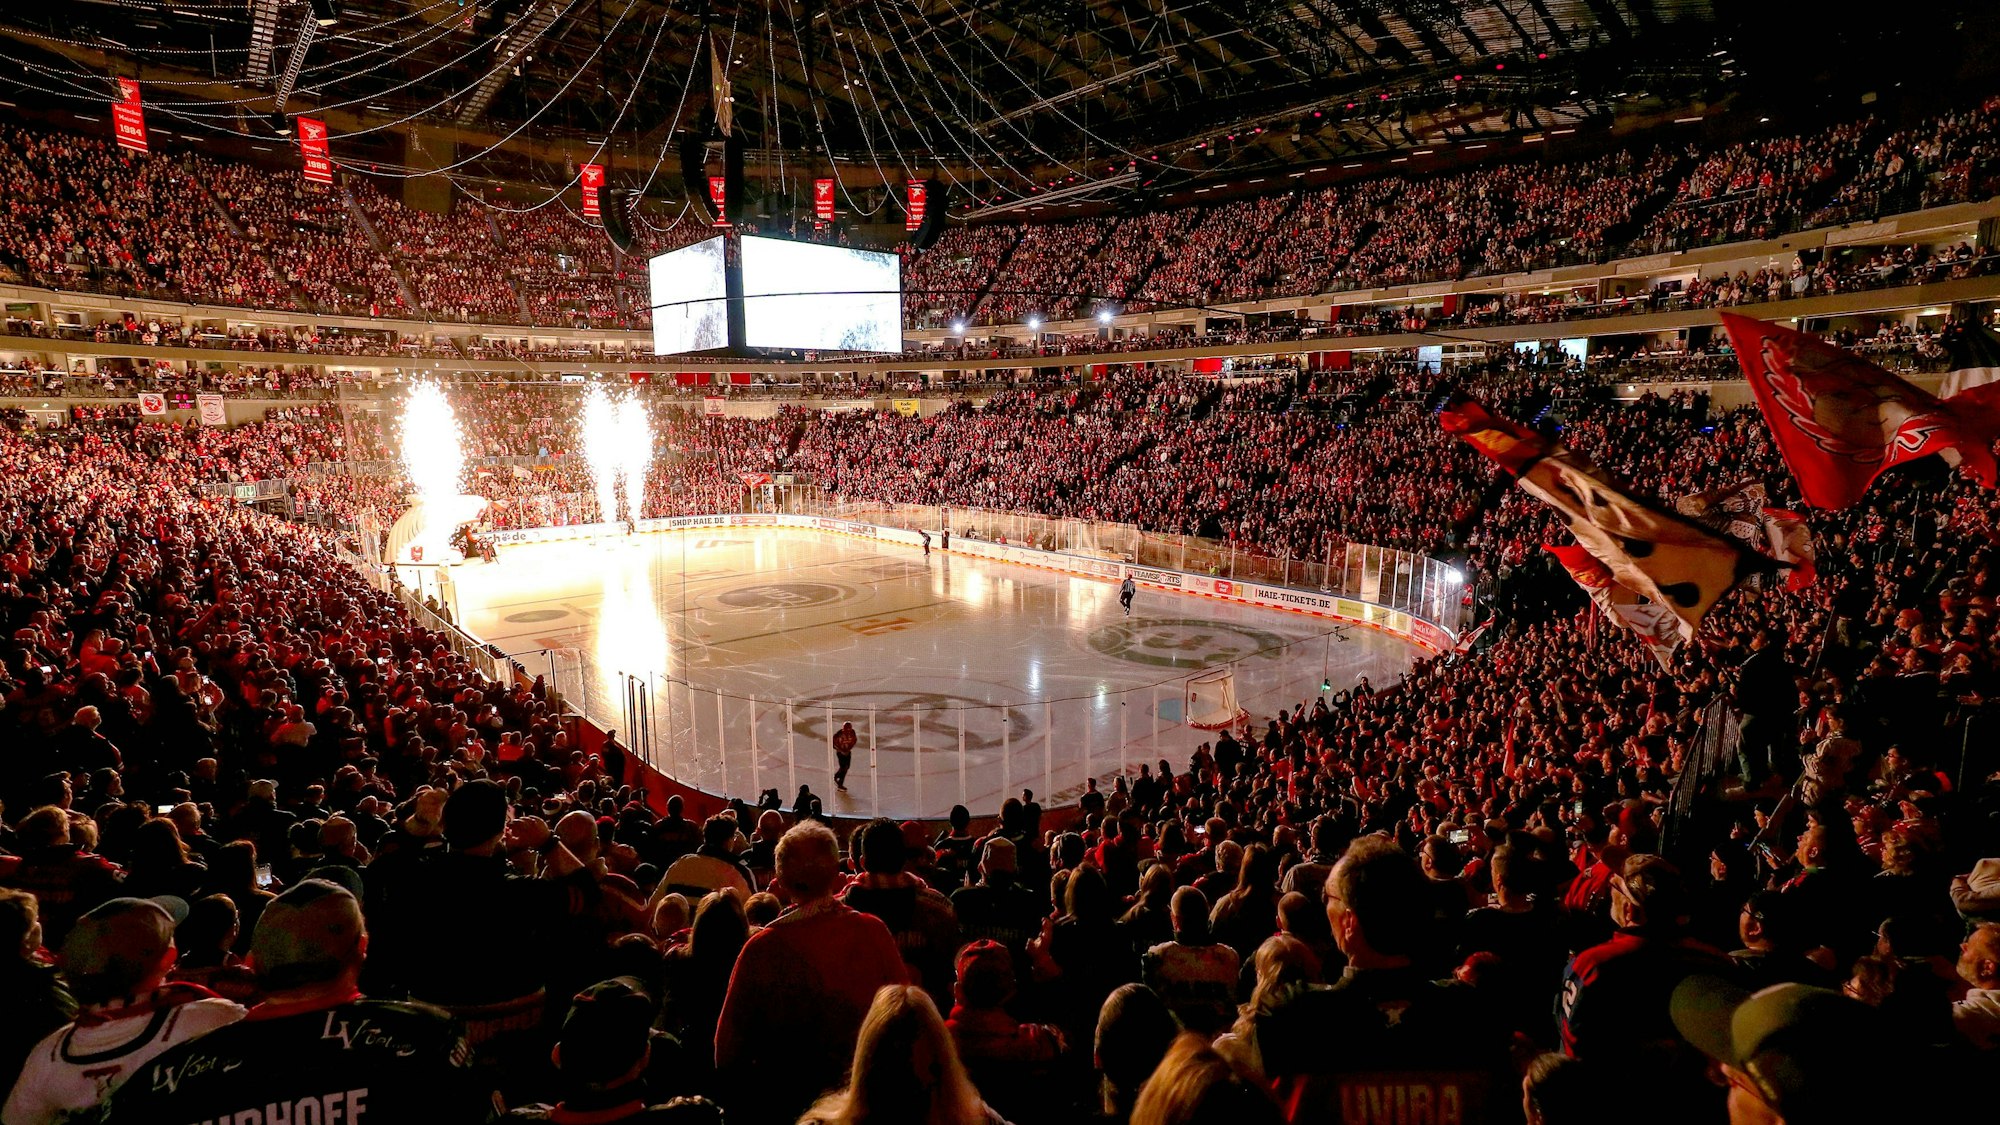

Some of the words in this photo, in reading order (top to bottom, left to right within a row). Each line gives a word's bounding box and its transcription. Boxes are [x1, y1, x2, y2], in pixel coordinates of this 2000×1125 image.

[119, 124, 142, 137] 1984
[306, 160, 328, 171] 1986
[1258, 589, 1331, 609] HAIE-TICKETS.DE
